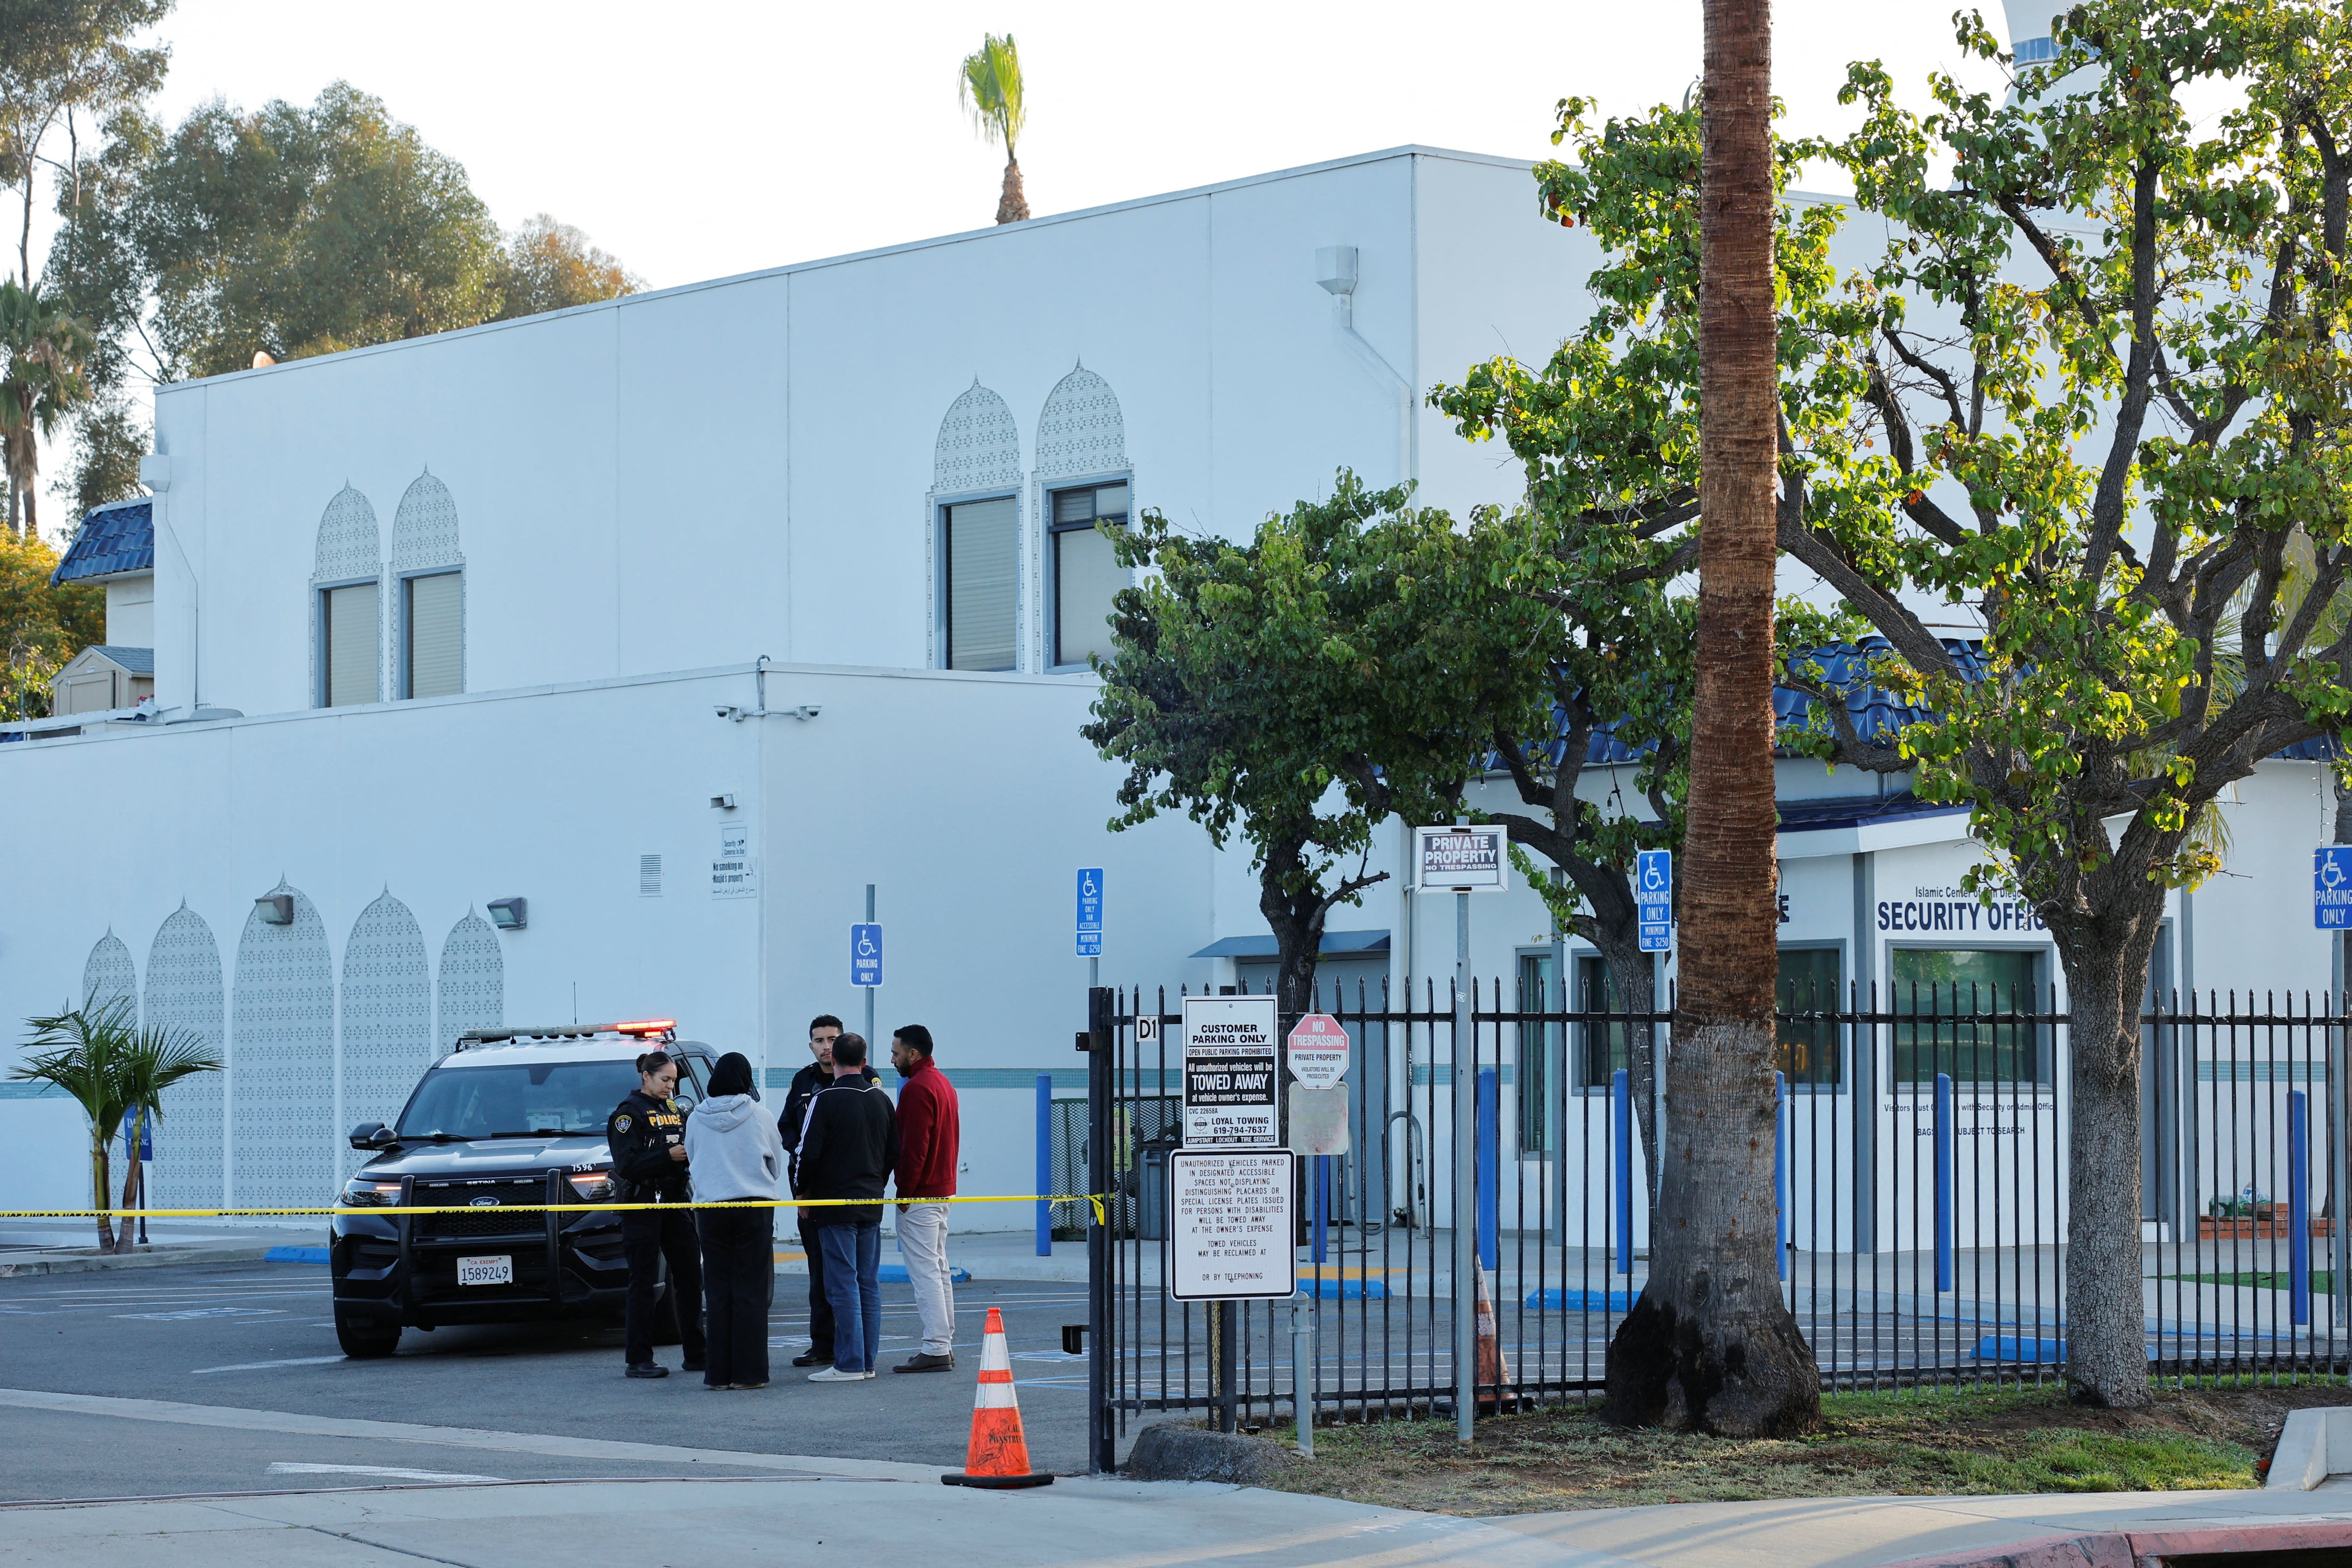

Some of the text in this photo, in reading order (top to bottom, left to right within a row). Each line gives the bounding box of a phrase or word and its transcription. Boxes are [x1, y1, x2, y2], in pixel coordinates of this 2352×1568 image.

[1432, 836, 1489, 850] PRIVATE
[1426, 849, 1496, 864] PROPERTY
[713, 863, 718, 871] No
[719, 862, 737, 871] smoking
[1915, 887, 1943, 897] Islamic
[2316, 890, 2352, 905] PARKING
[1641, 891, 1669, 905] PARKING
[1647, 907, 1663, 920] ONLY
[1878, 902, 1980, 930] SECURITY
[2323, 909, 2345, 924] ONLY
[1645, 926, 1665, 935] MINIMUM
[1081, 934, 1097, 942] MINIMUM
[1642, 937, 1668, 948] FINE $250
[1089, 944, 1100, 953] $250
[857, 959, 878, 968] PARKING
[861, 973, 874, 982] ONLY
[1140, 1020, 1156, 1038] D1
[1312, 1021, 1325, 1032] NO
[1293, 1035, 1344, 1046] TRESPASSING
[1196, 1063, 1228, 1072] unauthorized
[1229, 1063, 1252, 1071] vehicles
[1254, 1062, 1263, 1071] will
[1192, 1074, 1268, 1090] TOWED AWAY
[1242, 1094, 1268, 1103] expense.
[649, 1114, 682, 1126] POLICE
[462, 1266, 508, 1281] 1589249
